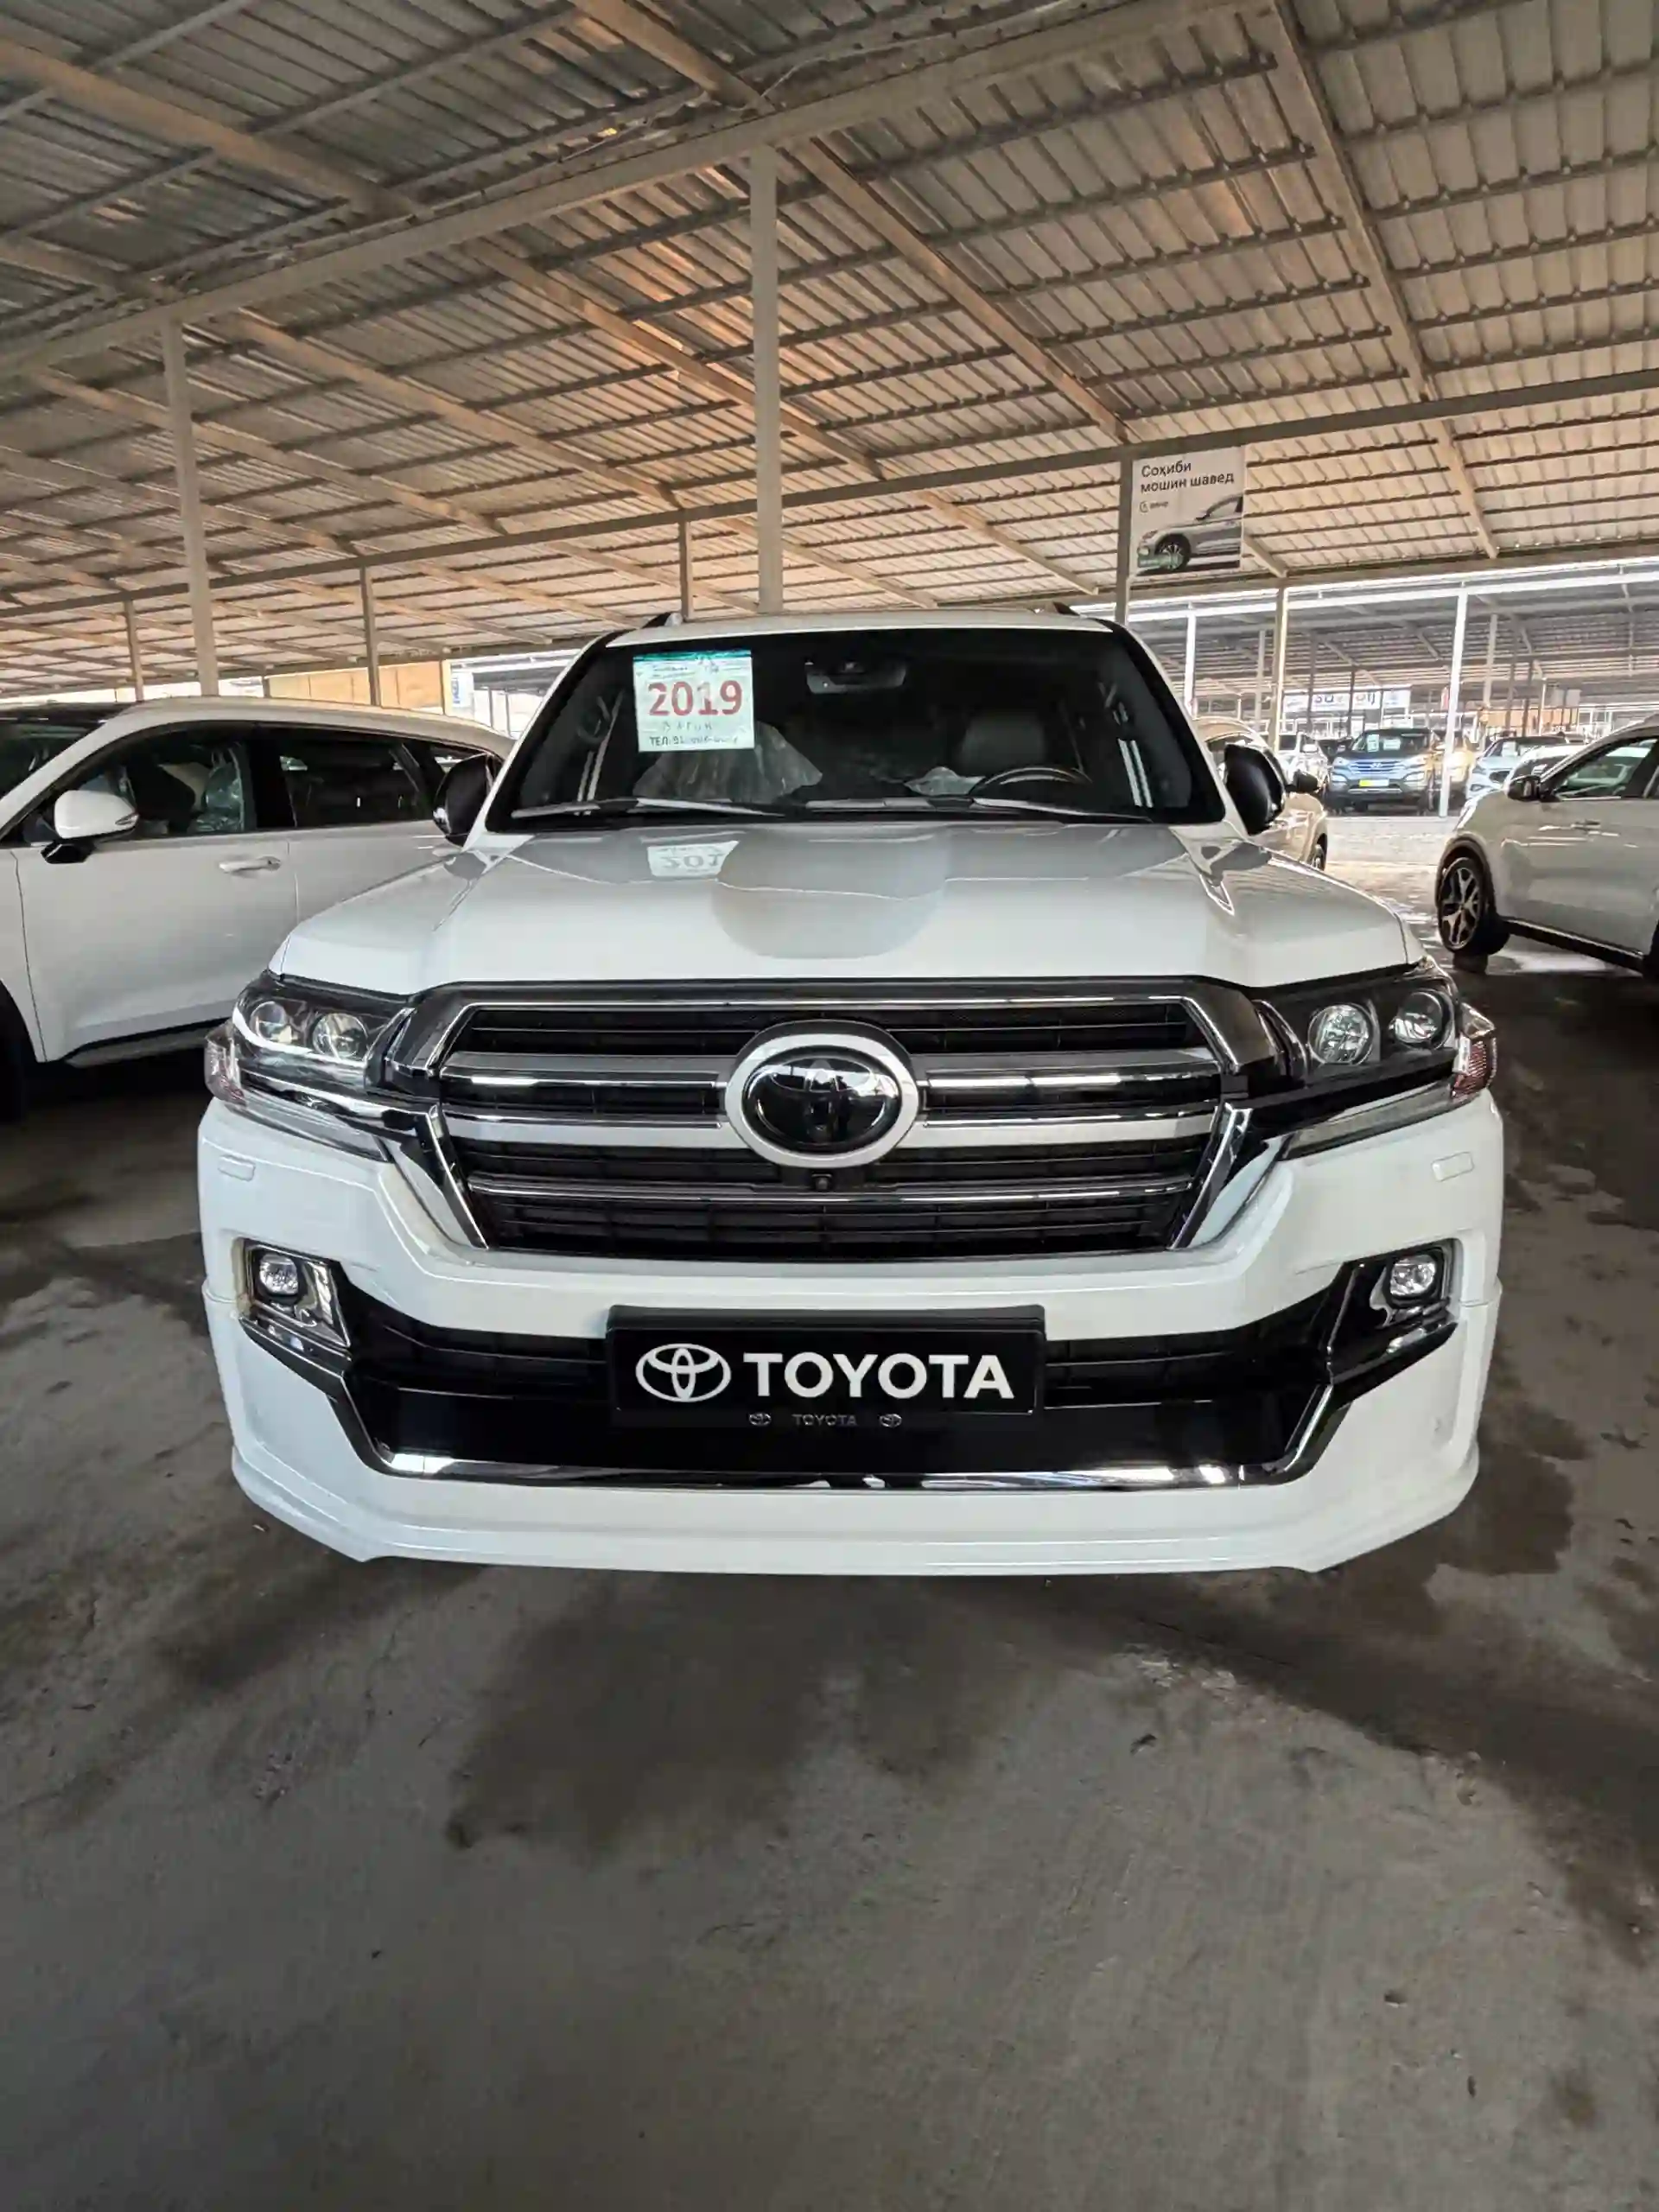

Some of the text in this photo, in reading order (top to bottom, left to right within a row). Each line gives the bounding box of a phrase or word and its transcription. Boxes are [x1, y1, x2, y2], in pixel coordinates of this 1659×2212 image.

[1141, 461, 1192, 478] Соҳиби
[1141, 473, 1235, 493] мошин шавед
[648, 680, 742, 716] 2019
[743, 1351, 1014, 1399] TOYOTA
[791, 1414, 857, 1426] TOYOTA
